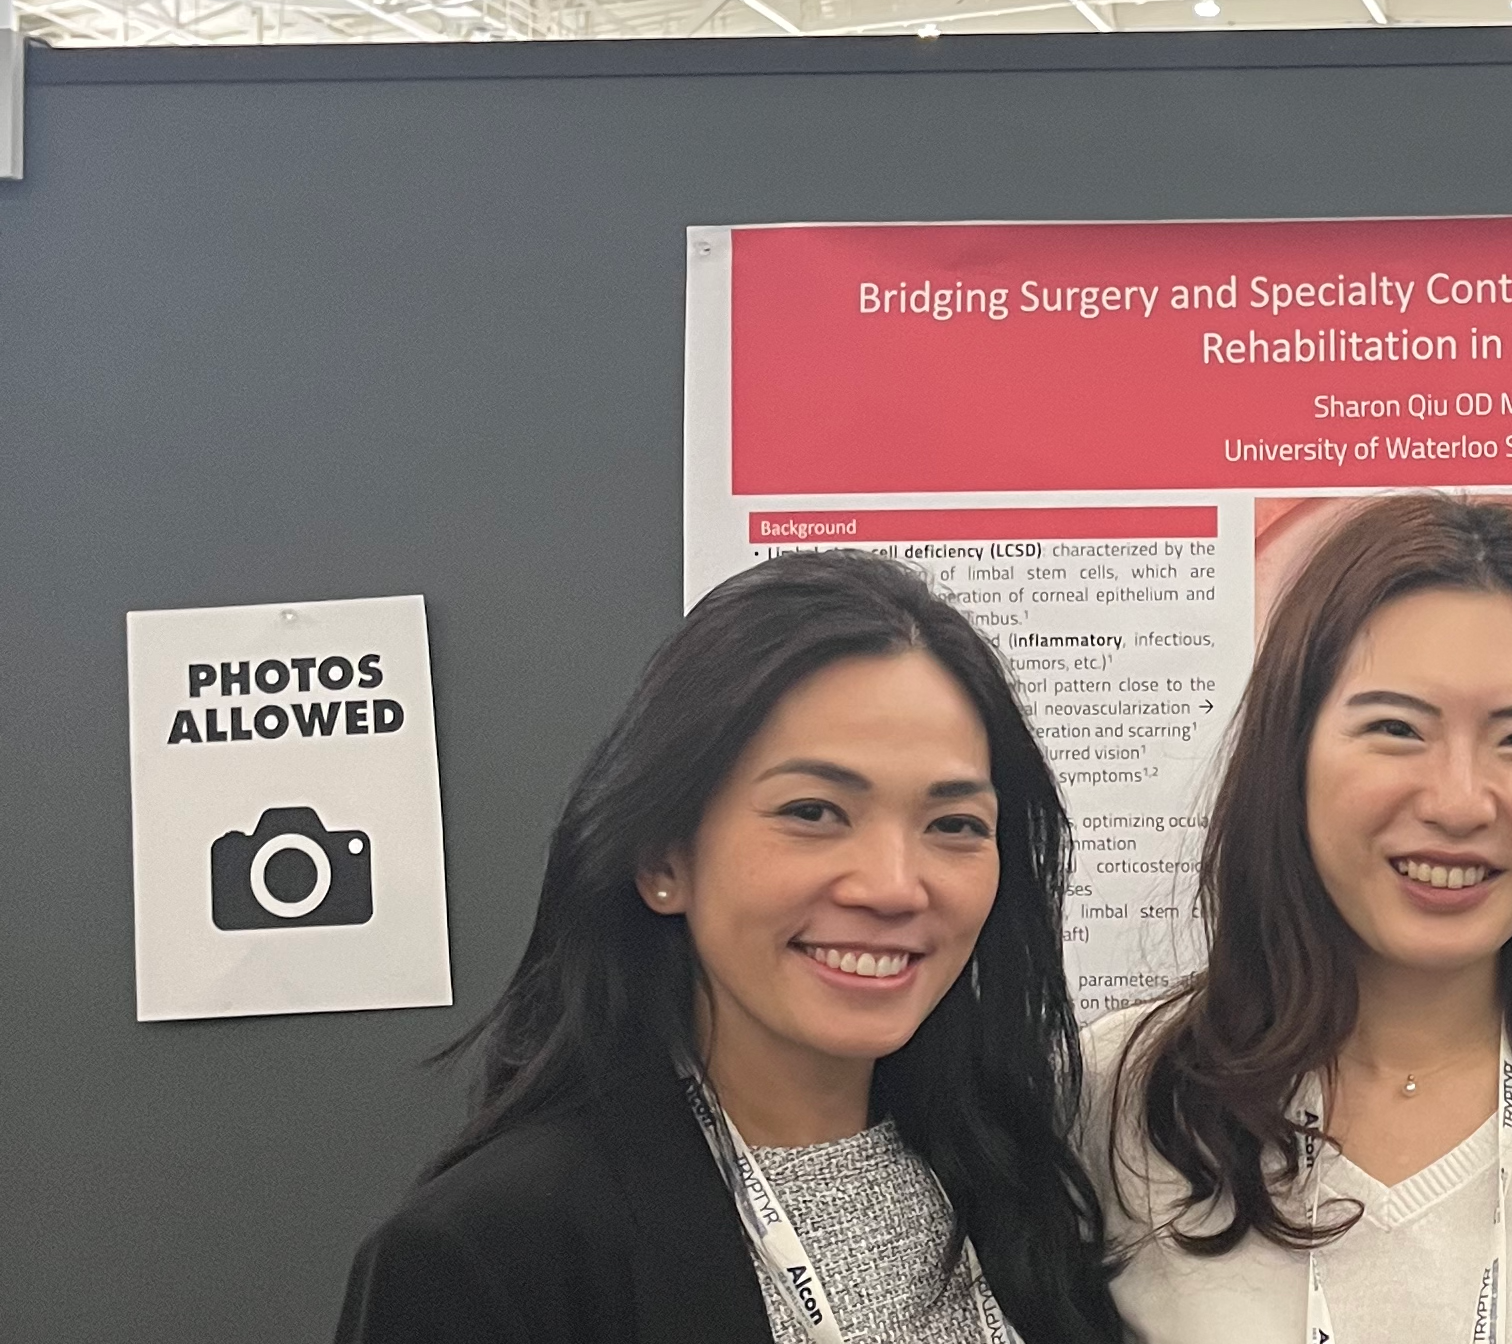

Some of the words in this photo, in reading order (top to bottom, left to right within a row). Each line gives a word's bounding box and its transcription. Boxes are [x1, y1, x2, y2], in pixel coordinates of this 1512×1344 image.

[859, 279, 1009, 321] Bridging
[1020, 280, 1159, 319] Surgery
[1170, 274, 1237, 310] and
[1250, 271, 1415, 316] Specialty
[1203, 328, 1457, 365] Rehabilitation
[1471, 327, 1502, 360] in
[1314, 394, 1401, 419] Sharon
[1408, 393, 1448, 421] Qiu
[1455, 392, 1493, 416] OD
[1224, 437, 1348, 467] University
[1354, 435, 1380, 460] of
[1385, 434, 1498, 460] Waterloo
[760, 518, 857, 539] Background
[904, 543, 984, 563] deficiency
[1052, 541, 1158, 558] characterized
[1164, 541, 1184, 560] by
[1190, 541, 1215, 556] the
[939, 566, 957, 580] of
[968, 565, 1014, 581] limbal
[1026, 566, 1067, 581] stem
[1079, 564, 1119, 582] cells,
[1131, 563, 1177, 579] which
[1190, 566, 1216, 579] are
[189, 654, 383, 697] PHOTOS
[1054, 678, 1111, 696] pattern
[1118, 677, 1158, 692] close
[1166, 678, 1183, 692] to
[1190, 677, 1216, 692] the
[1044, 700, 1192, 716] neovascularization
[167, 699, 405, 744] ALLOWED
[1082, 815, 1165, 831] optimizing
[1078, 973, 1169, 991] parameters
[786, 1265, 824, 1326] Alcon
